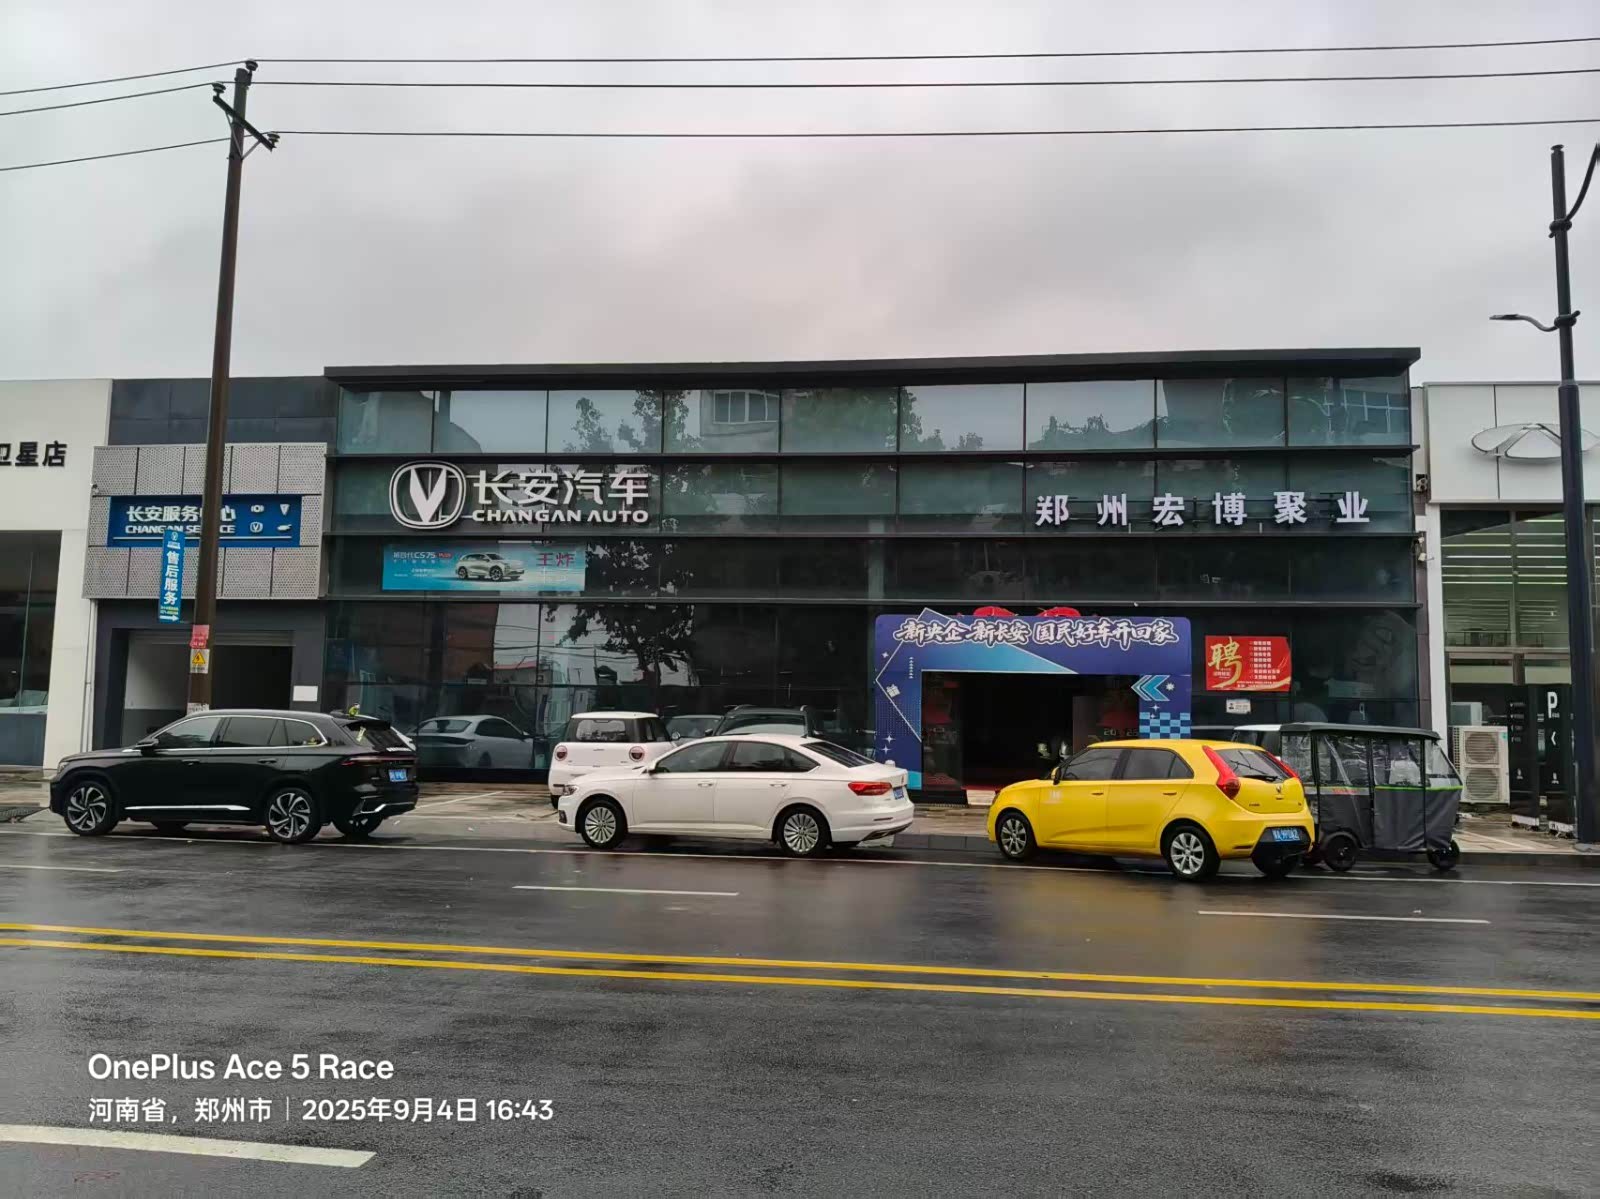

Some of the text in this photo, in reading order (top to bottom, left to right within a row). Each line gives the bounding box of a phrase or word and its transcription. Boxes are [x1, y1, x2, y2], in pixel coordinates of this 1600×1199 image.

[473, 470, 649, 505] 长安汽车
[126, 505, 236, 522] 长安服务心
[472, 509, 649, 523] CHANGAN AUTO
[1035, 491, 1370, 526] 郑州宏博聚业
[185, 525, 236, 533] SECE
[536, 552, 576, 568] 王炸
[164, 550, 180, 606] 售后服务
[1032, 617, 1179, 650] 国民好车开回家
[1207, 636, 1243, 689] 聘
